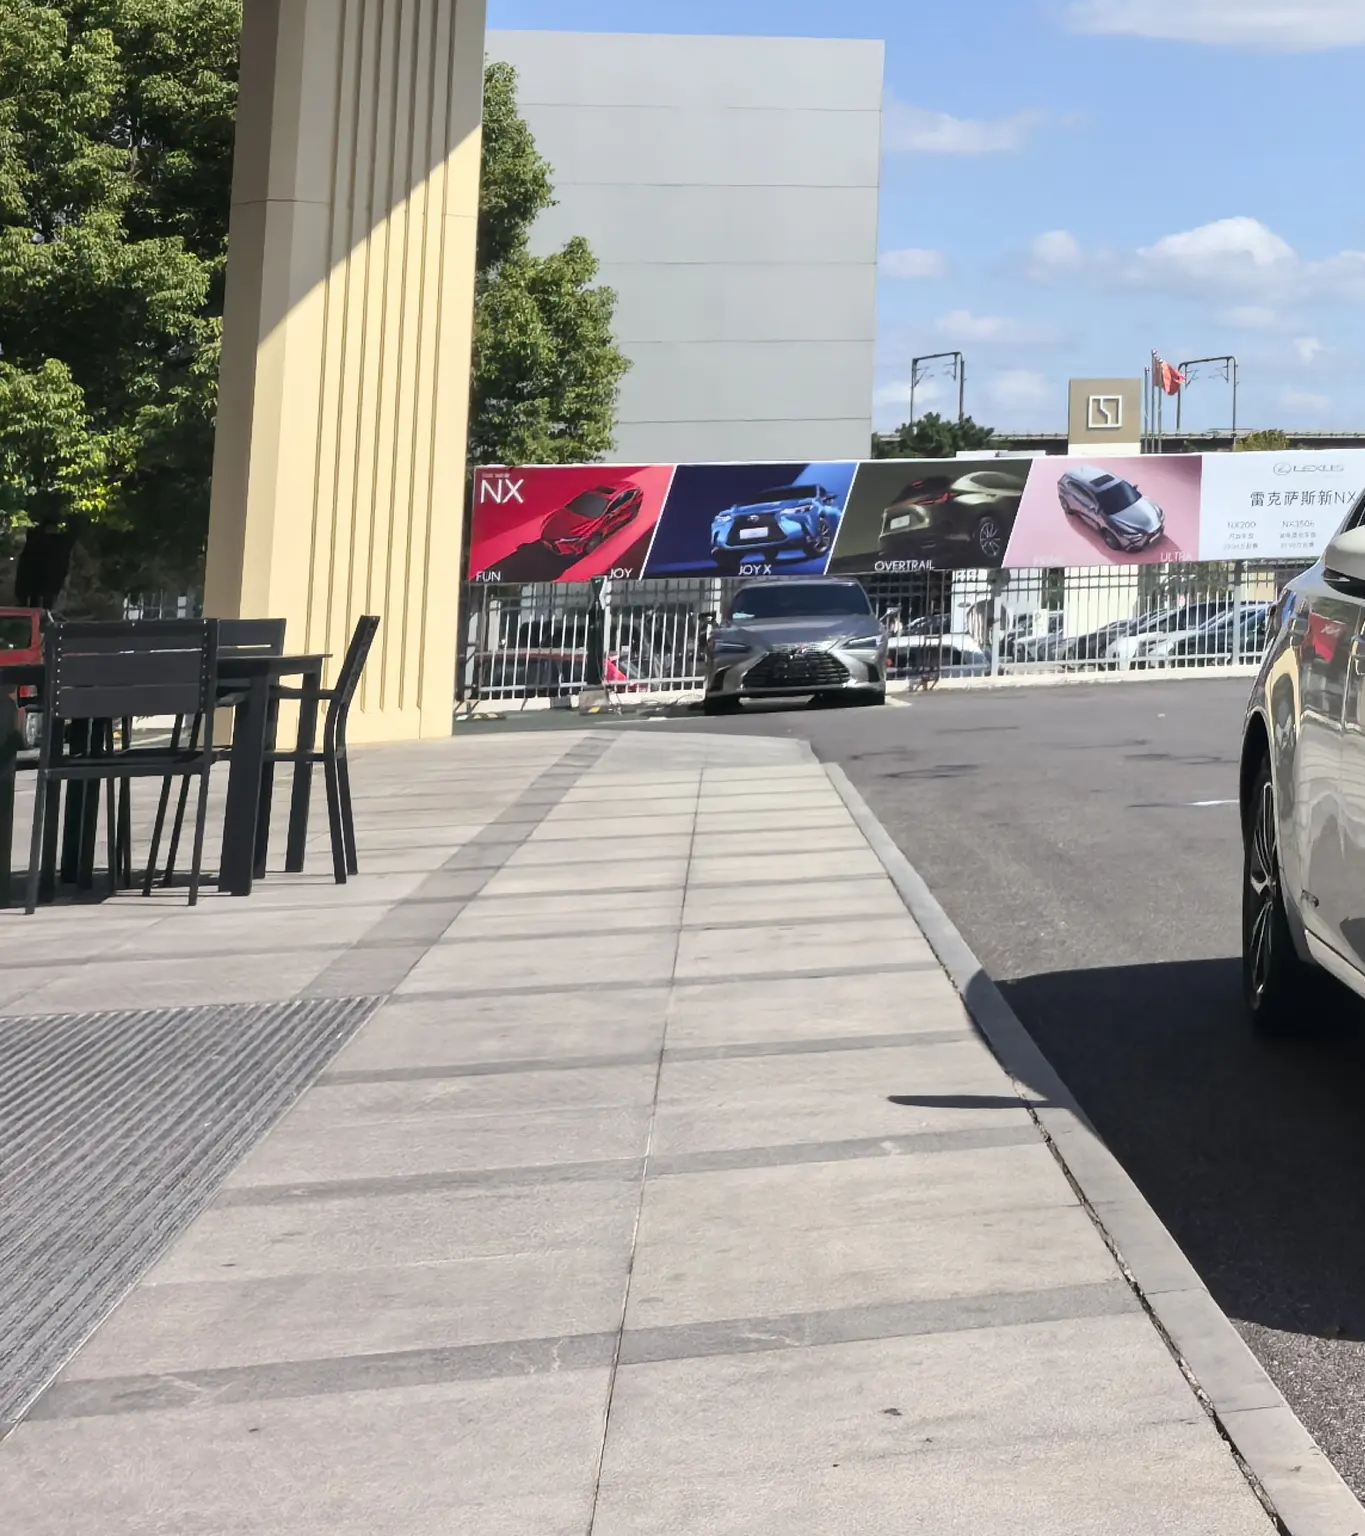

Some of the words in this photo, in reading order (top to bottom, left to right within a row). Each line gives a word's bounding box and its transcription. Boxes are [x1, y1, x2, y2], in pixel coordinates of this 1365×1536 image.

[480, 478, 525, 504] NX
[609, 567, 633, 580] JOY
[738, 564, 762, 575] JOY
[763, 564, 772, 575] X
[475, 571, 501, 582] FUN
